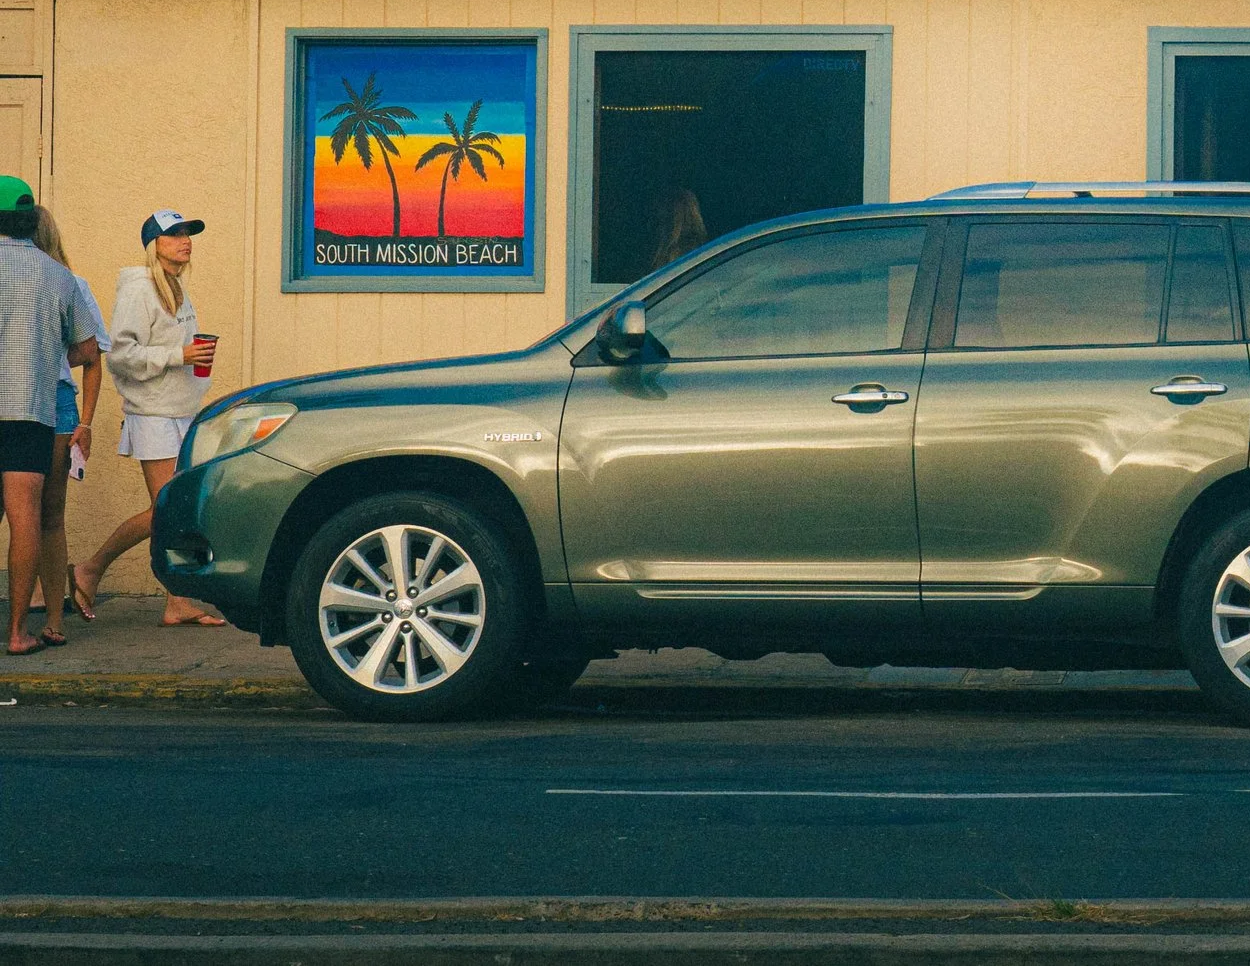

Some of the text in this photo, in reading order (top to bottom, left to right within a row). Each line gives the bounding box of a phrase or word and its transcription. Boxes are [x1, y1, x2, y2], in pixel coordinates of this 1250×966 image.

[316, 244, 518, 265] SOUTH MISSION BEACH
[484, 432, 533, 442] HYBRID
